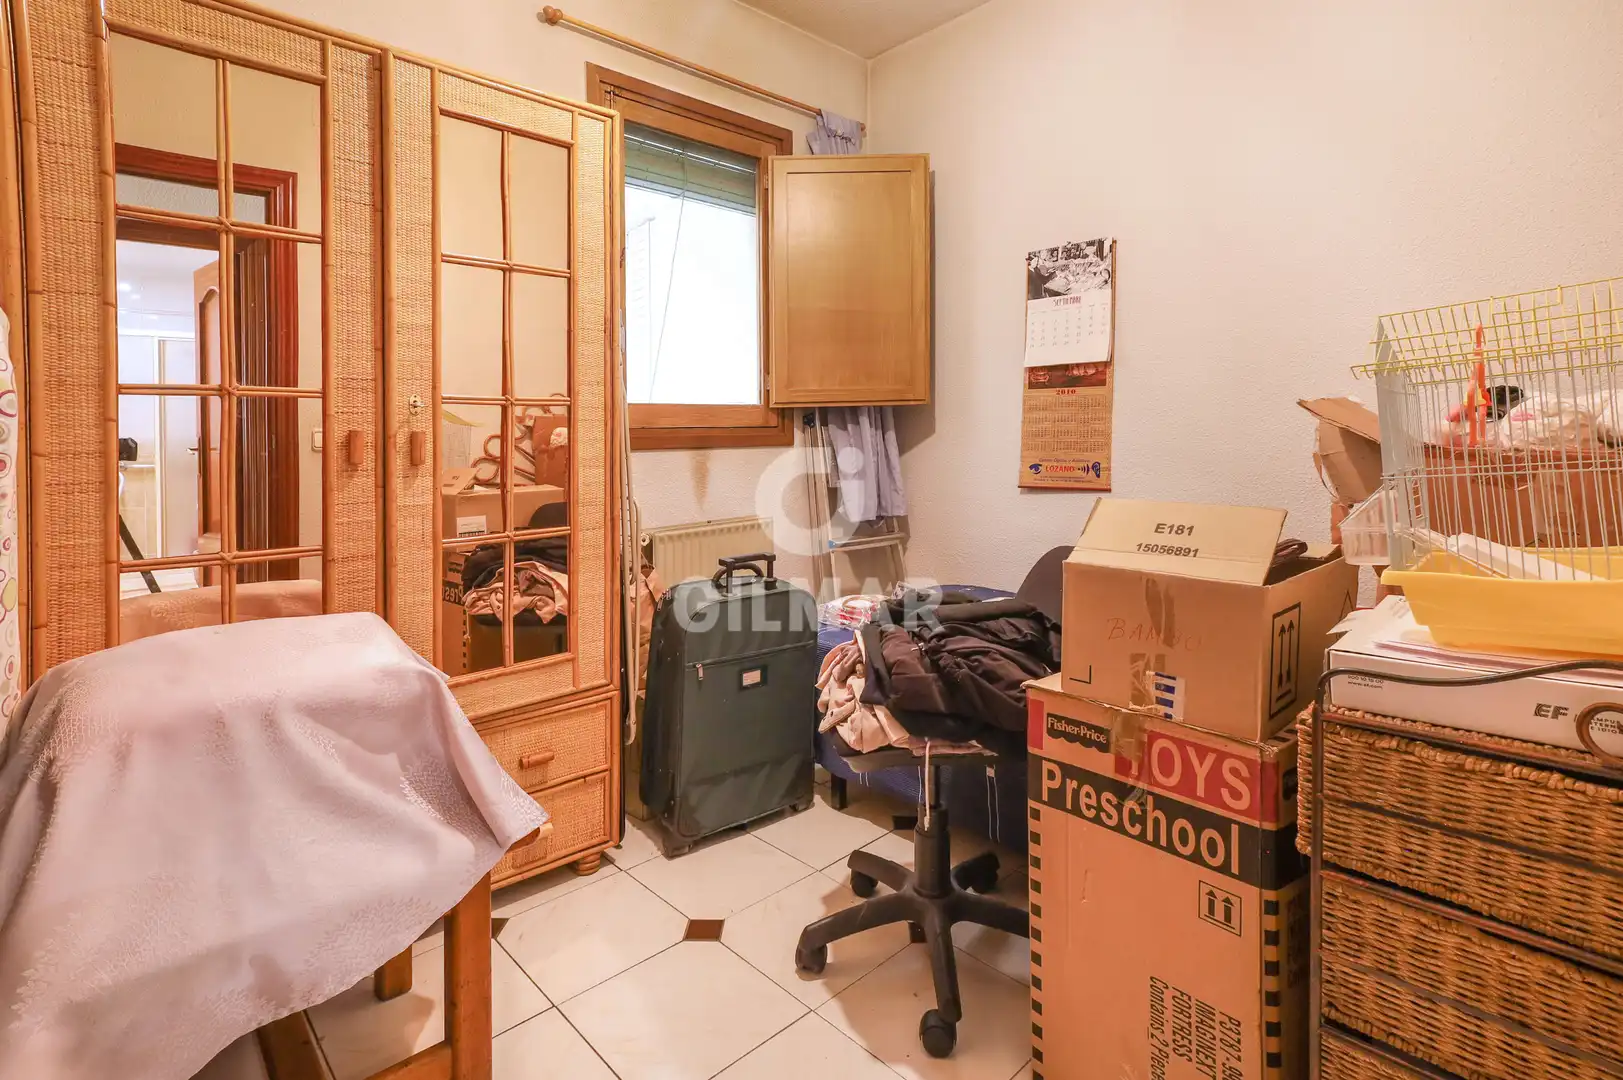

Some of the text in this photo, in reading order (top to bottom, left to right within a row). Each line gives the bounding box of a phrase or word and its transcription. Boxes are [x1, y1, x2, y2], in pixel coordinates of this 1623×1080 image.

[1045, 464, 1075, 472] LOZANO
[1154, 522, 1195, 536] E181
[1135, 542, 1199, 558] 15056891
[1533, 702, 1569, 720] EF
[1047, 717, 1107, 744] Fisher-Price
[1041, 759, 1240, 876] Preschool
[1150, 976, 1168, 1035] Contains
[1172, 987, 1192, 1063] FORTRESS
[1195, 998, 1217, 1080] IMAGINEXT
[1151, 1043, 1170, 1080] Piece
